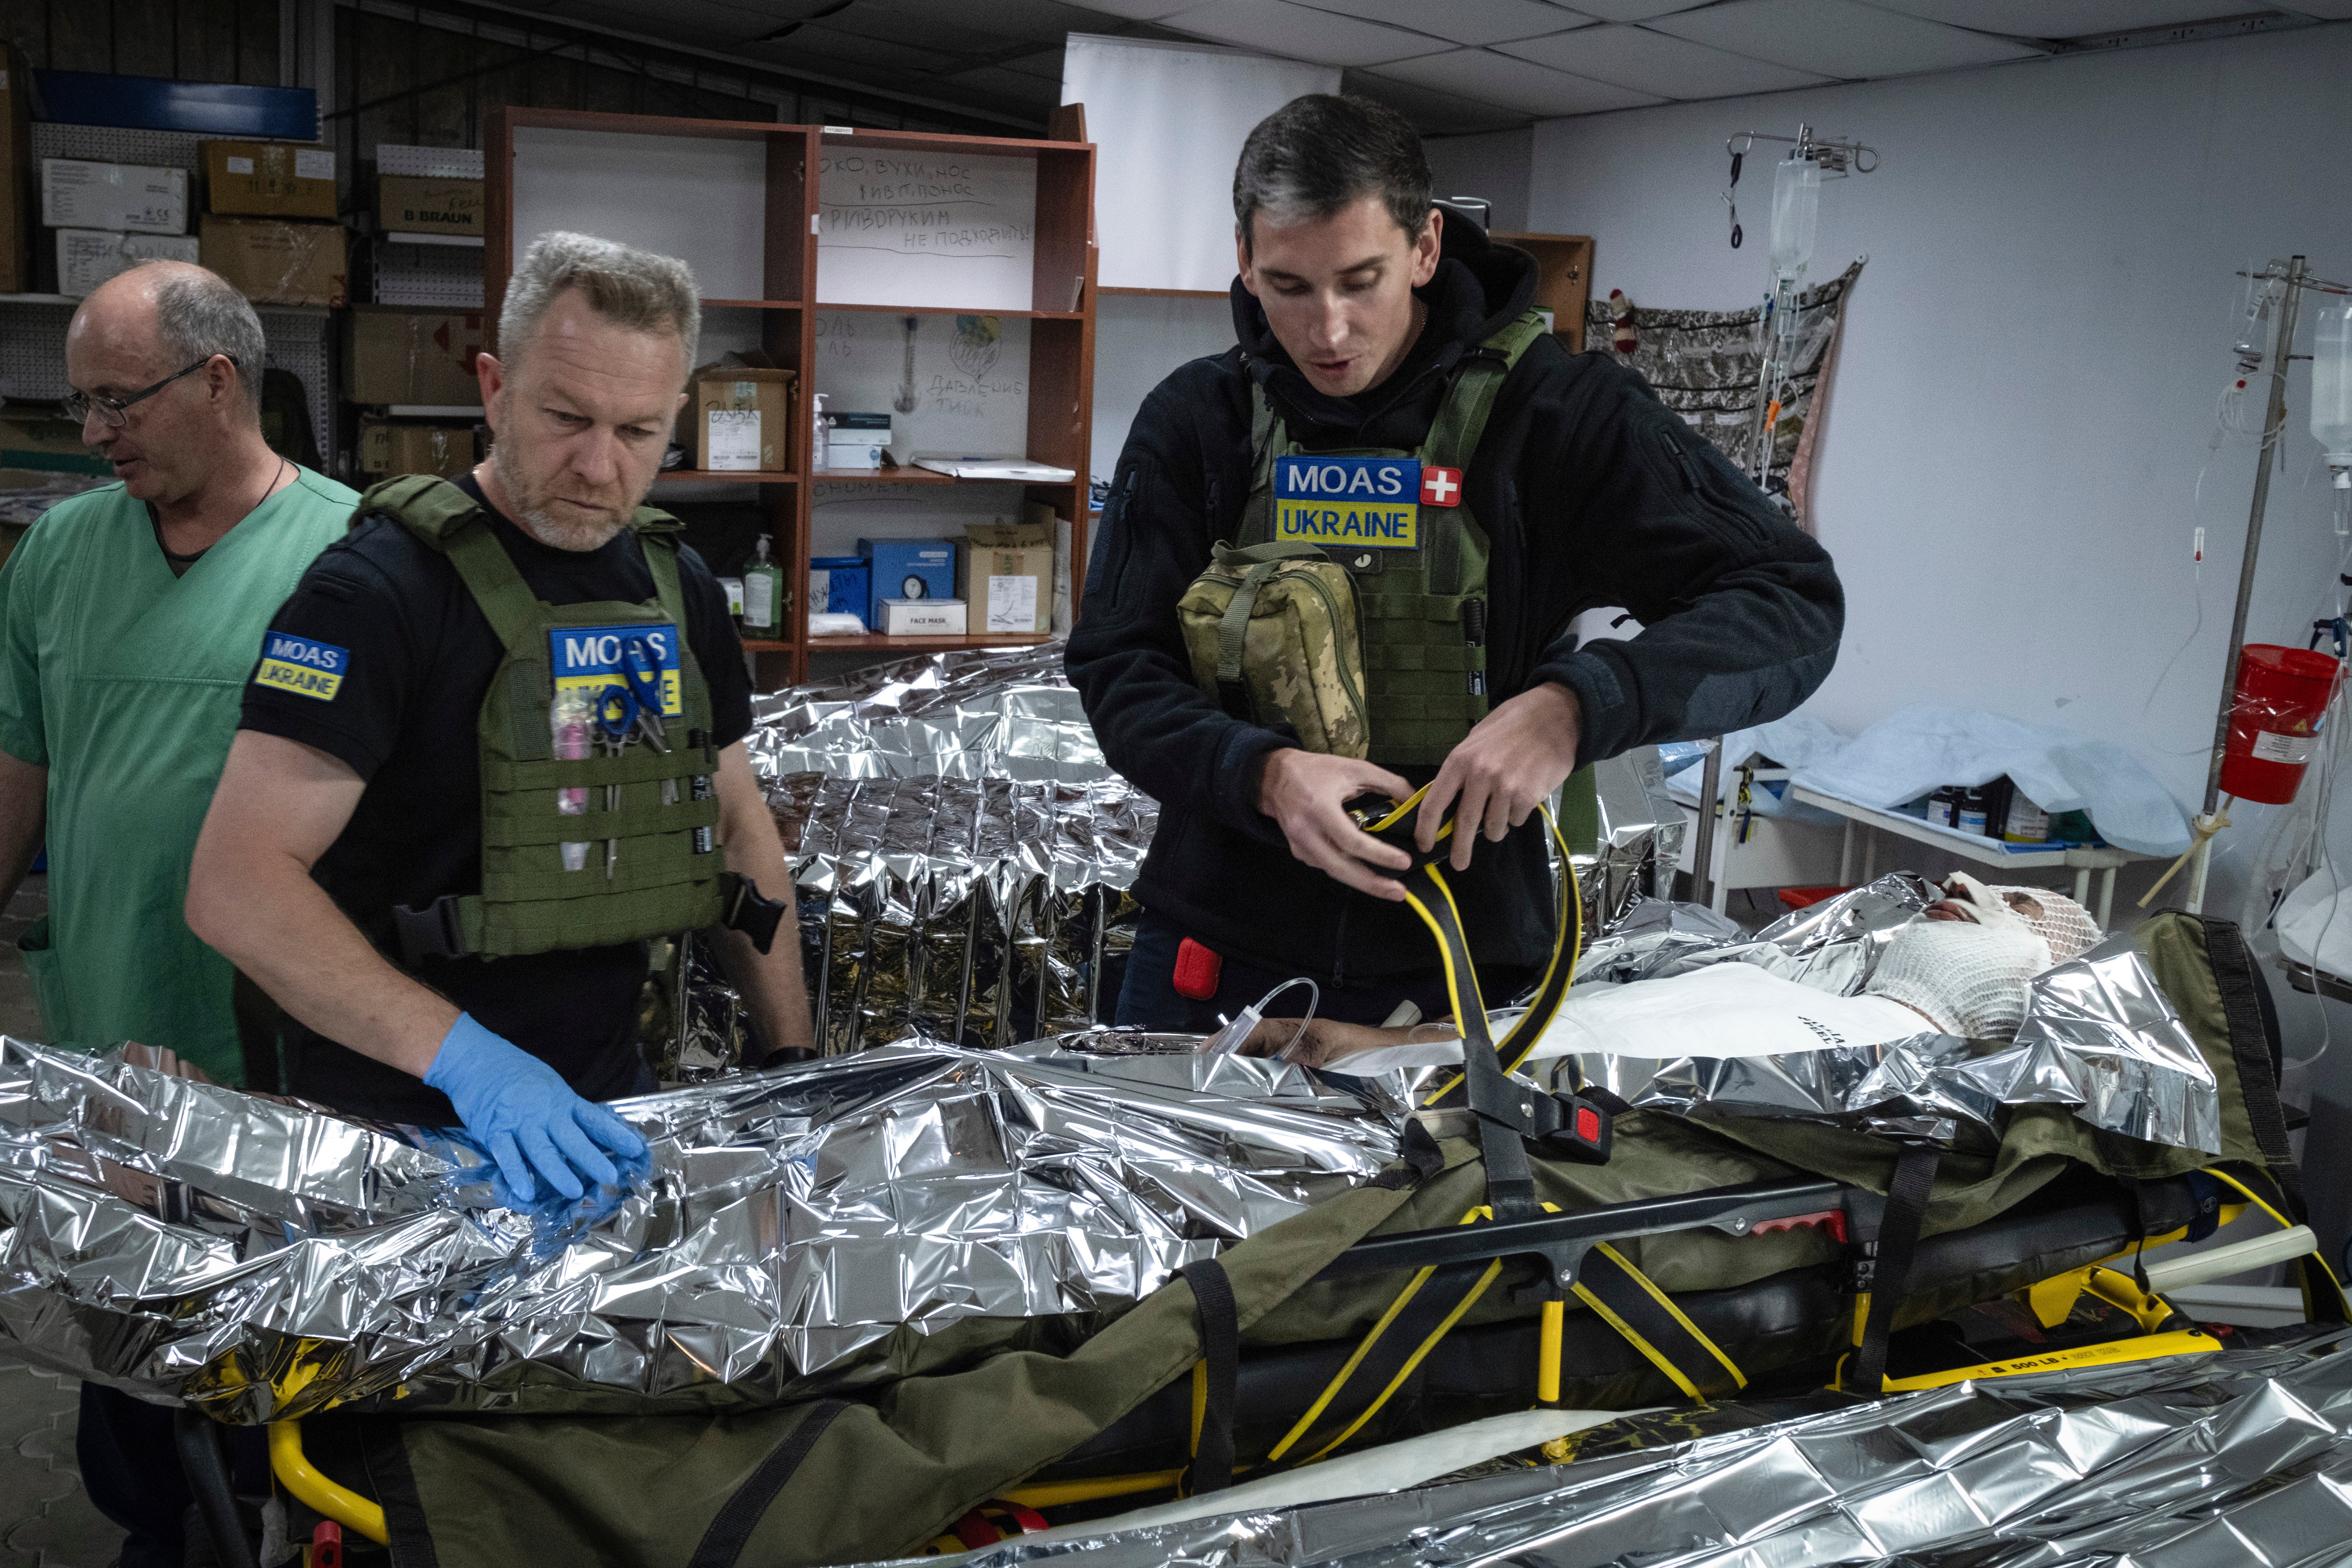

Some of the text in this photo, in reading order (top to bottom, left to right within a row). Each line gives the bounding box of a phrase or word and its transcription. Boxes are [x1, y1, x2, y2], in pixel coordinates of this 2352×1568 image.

[404, 210, 472, 223] B BRAUN
[905, 232, 926, 248] НЕ
[1288, 465, 1401, 495] MOAS
[1283, 509, 1408, 538] UKRAINE
[271, 638, 339, 668] MOAS
[1803, 1022, 1832, 1044] PEEL
[2011, 1361, 2038, 1370] 500
[2039, 1357, 2060, 1365] LB
